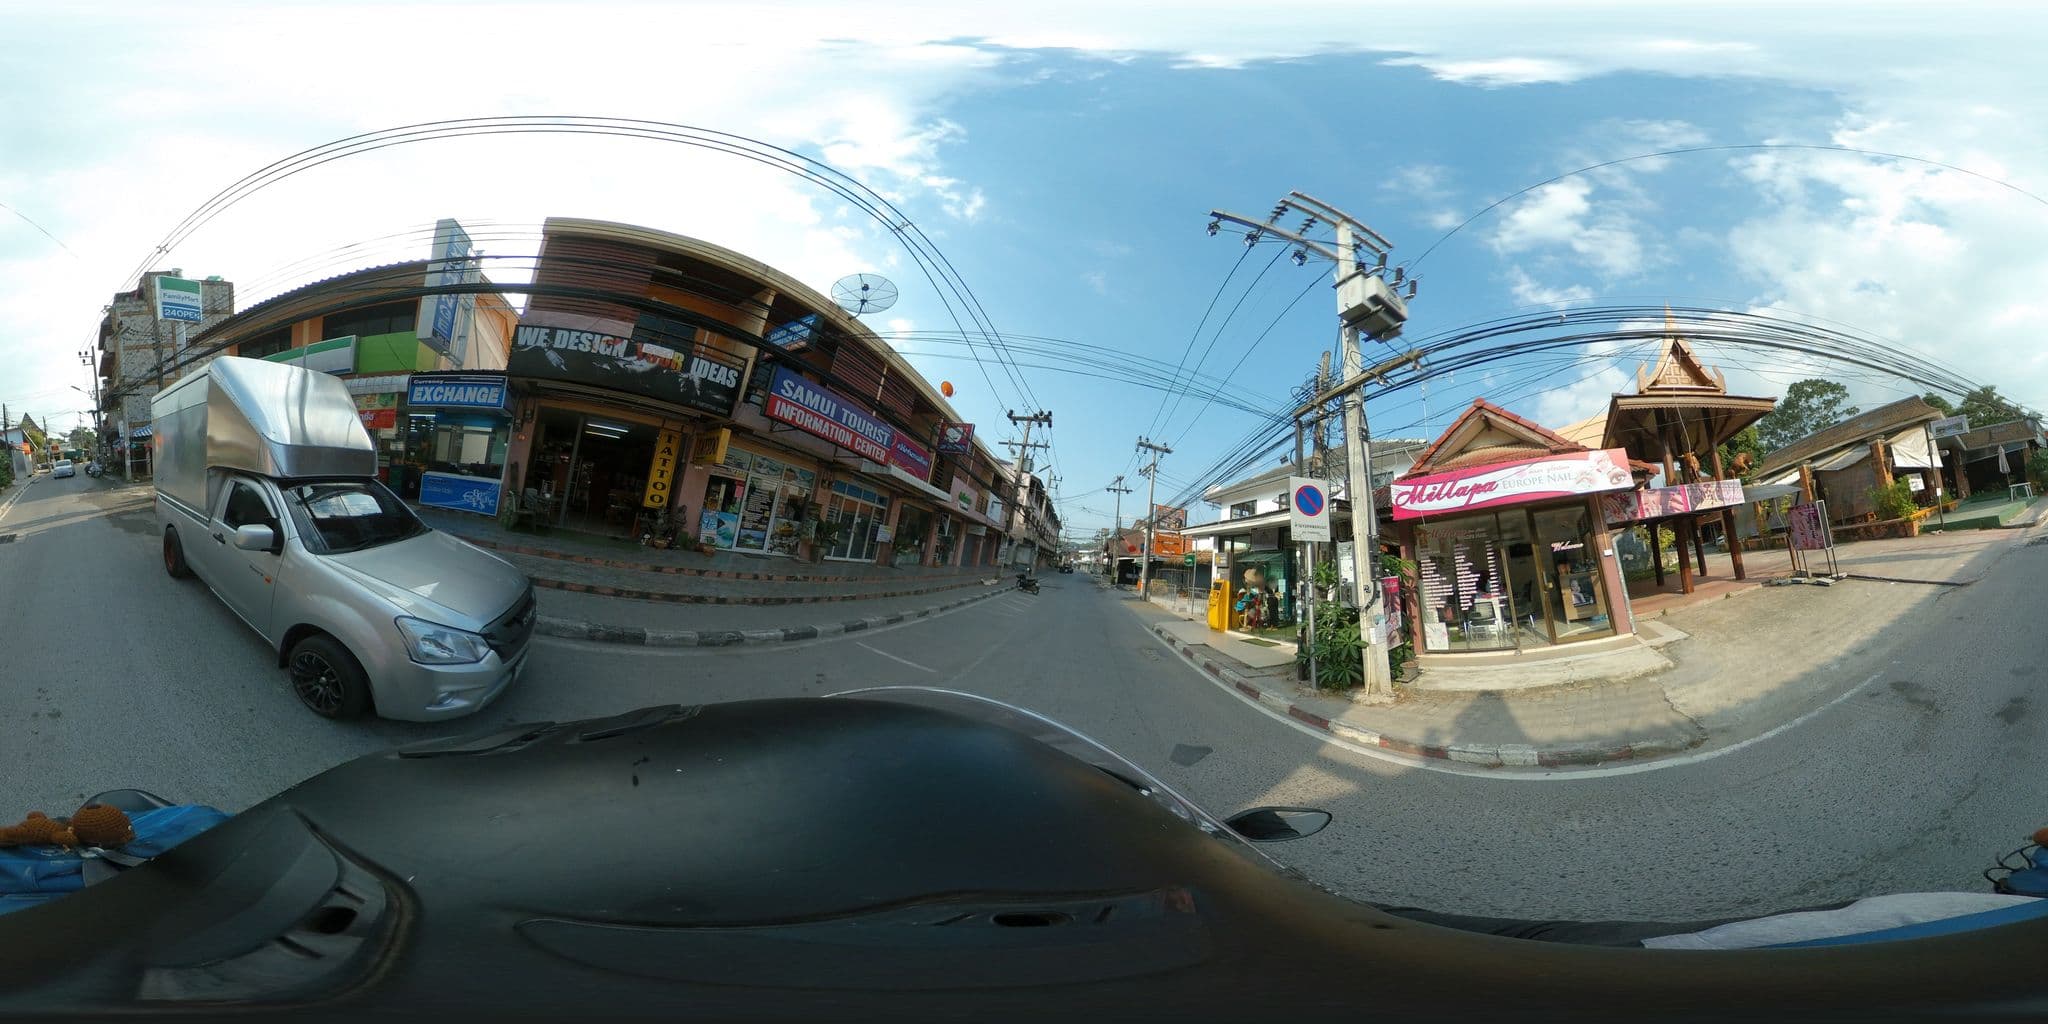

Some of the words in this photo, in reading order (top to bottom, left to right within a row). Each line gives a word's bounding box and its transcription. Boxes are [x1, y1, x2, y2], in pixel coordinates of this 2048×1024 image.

[517, 326, 550, 347] WE
[553, 329, 629, 357] DESIGN
[690, 357, 739, 388] IDEAS
[412, 386, 501, 404] EXCHANGE
[781, 379, 837, 418] SAMUI
[841, 407, 891, 446] TOURIST
[774, 400, 853, 445] INFORMATION
[854, 437, 887, 462] CENTER
[650, 432, 677, 503] TATTOO
[1395, 480, 1499, 505] Millapa
[1502, 475, 1545, 490] EUROPE
[1547, 471, 1576, 484] NAIL
